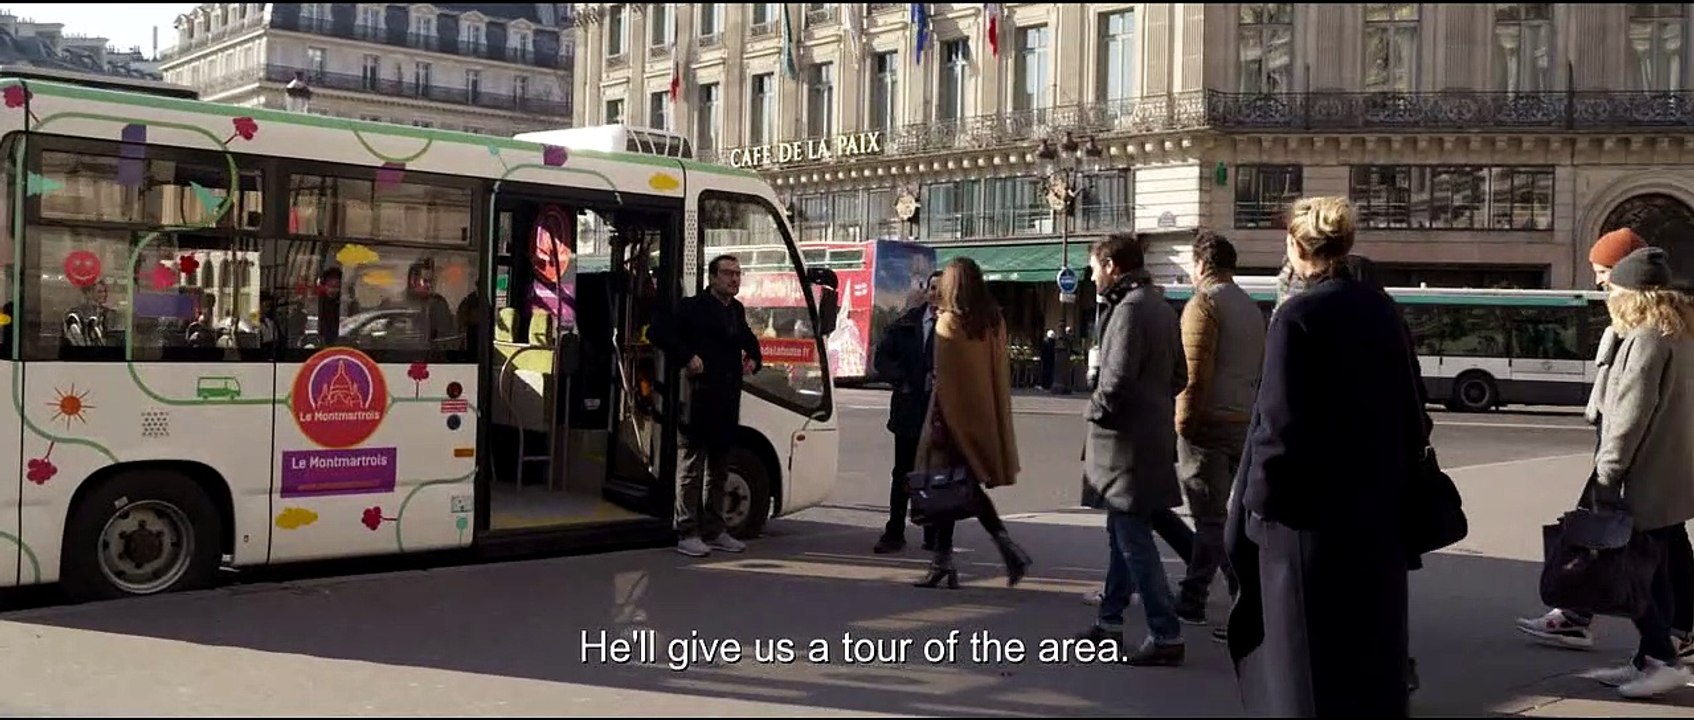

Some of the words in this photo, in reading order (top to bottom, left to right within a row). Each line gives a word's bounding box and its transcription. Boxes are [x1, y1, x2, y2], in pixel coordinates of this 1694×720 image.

[780, 142, 802, 163] DE
[808, 138, 830, 159] LA
[837, 131, 880, 155] PAIX
[300, 411, 312, 422] Le
[315, 410, 380, 421] Montmartrois
[292, 457, 306, 469] Le
[310, 454, 388, 468] Montmartrois
